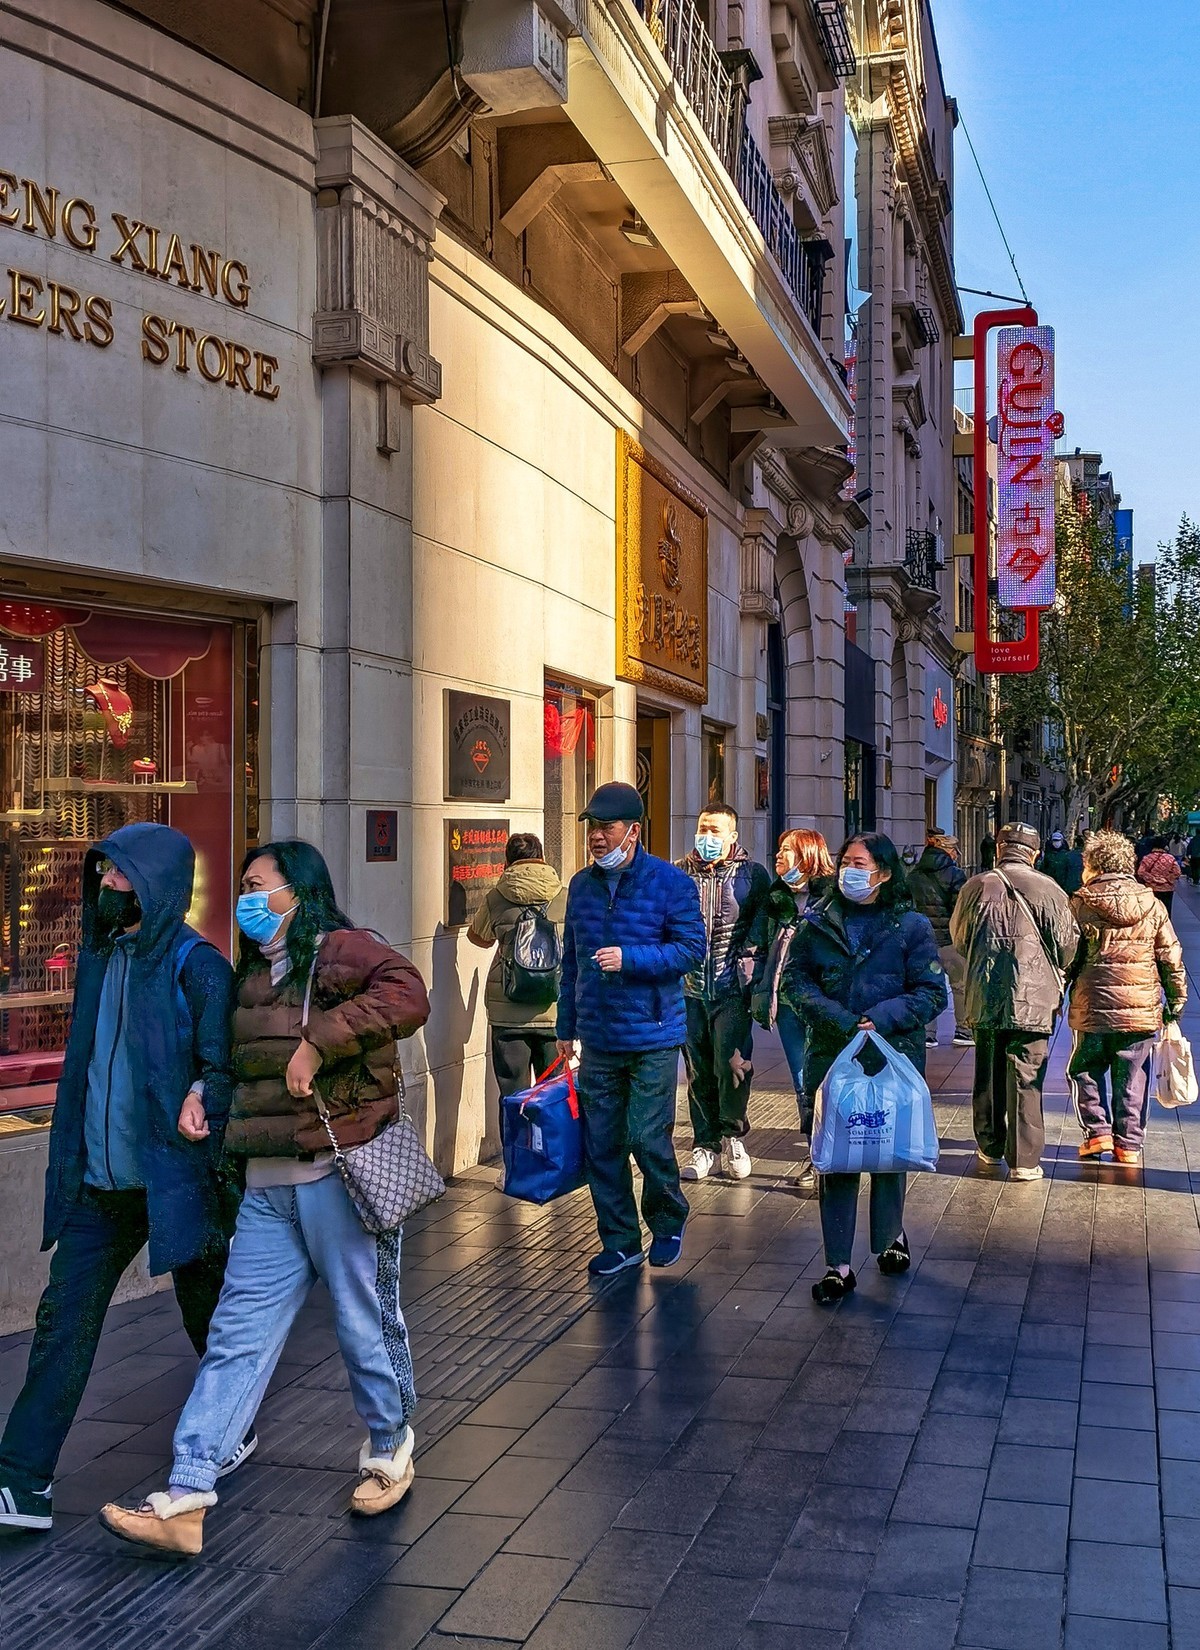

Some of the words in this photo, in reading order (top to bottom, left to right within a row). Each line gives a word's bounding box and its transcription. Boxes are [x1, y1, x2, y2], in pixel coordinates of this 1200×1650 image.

[110, 212, 251, 309] XIANG
[0, 268, 114, 347] ERS
[141, 314, 281, 401] STORE
[991, 654, 1030, 663] yourself
